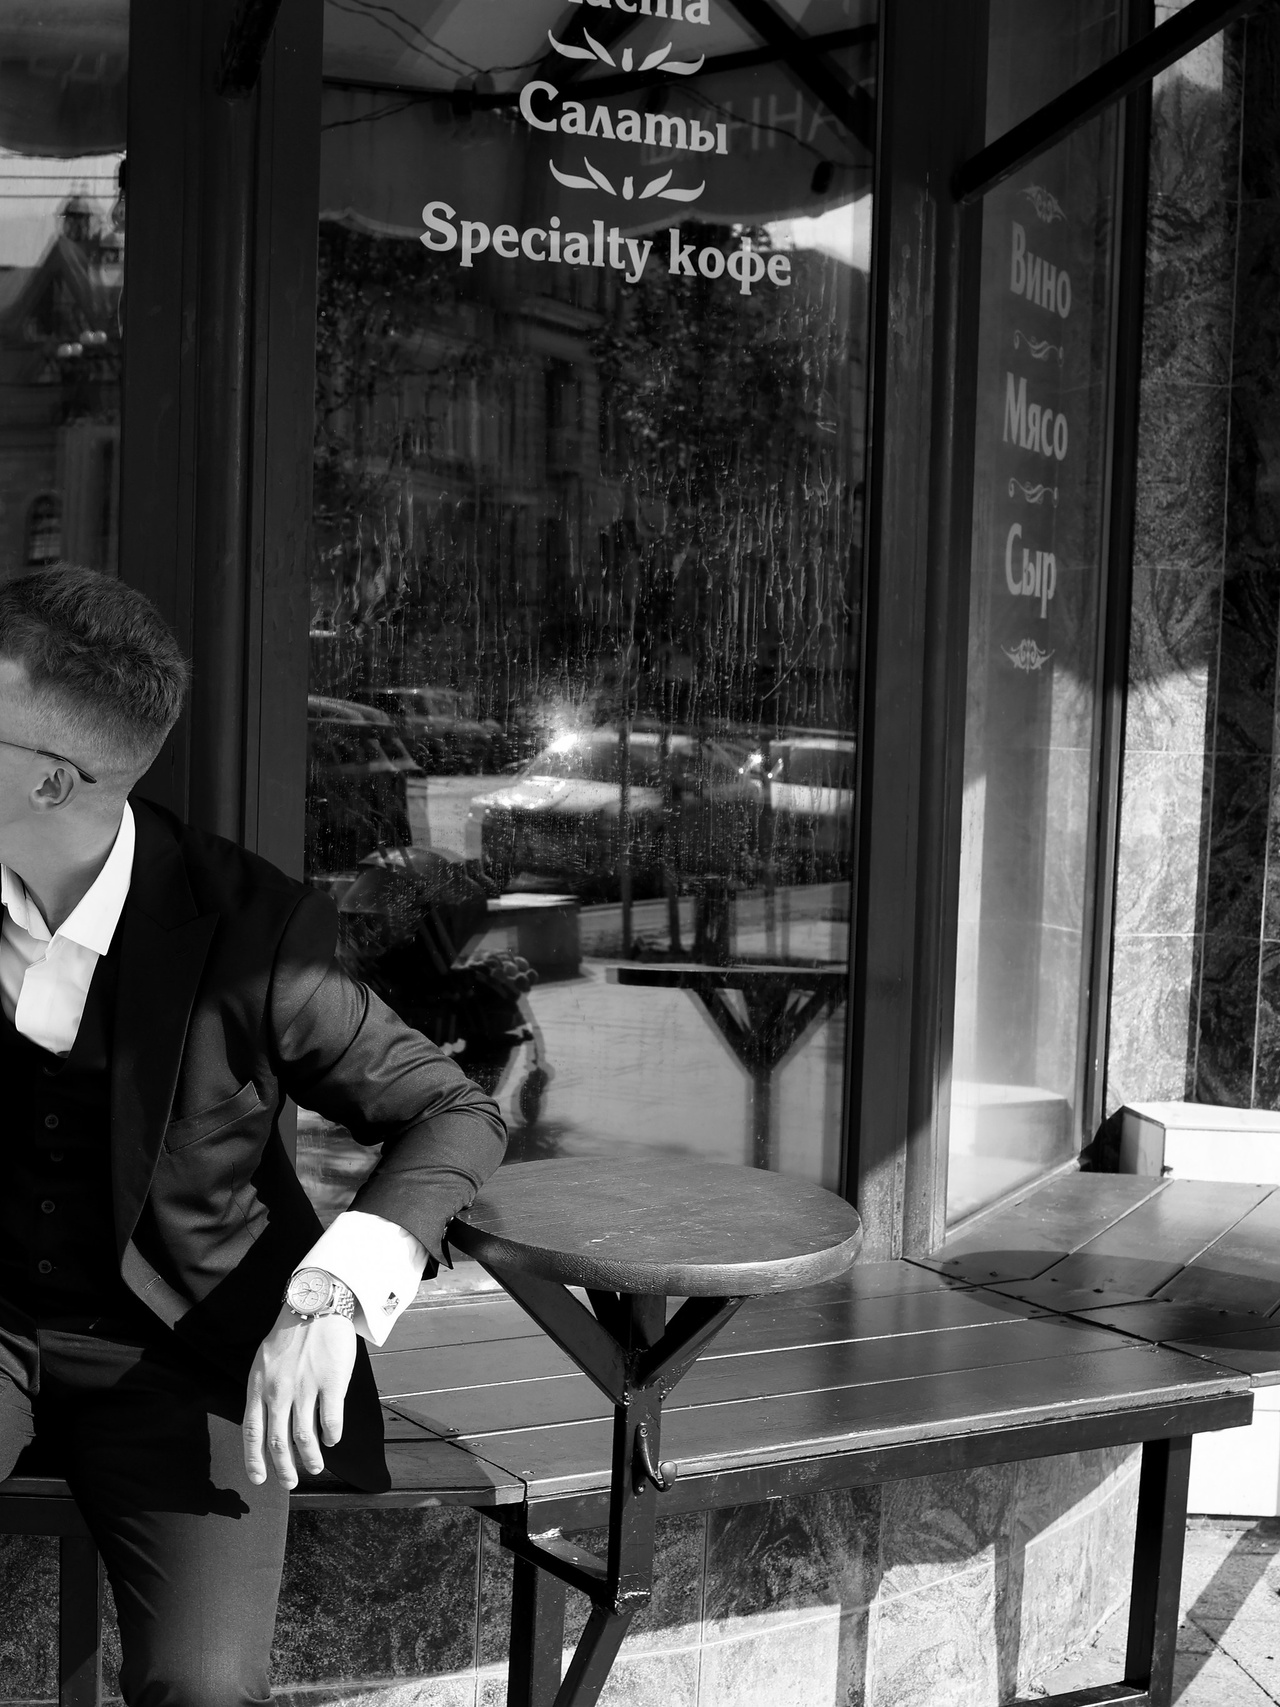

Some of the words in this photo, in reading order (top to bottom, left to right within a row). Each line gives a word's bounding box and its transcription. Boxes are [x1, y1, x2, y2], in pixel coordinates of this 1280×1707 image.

[520, 81, 729, 155] Салаты
[420, 201, 654, 284] Specialty
[667, 228, 792, 296] кофе
[1010, 220, 1072, 319] Вино
[1002, 371, 1069, 461] Мясо
[1005, 522, 1057, 620] Сыр
